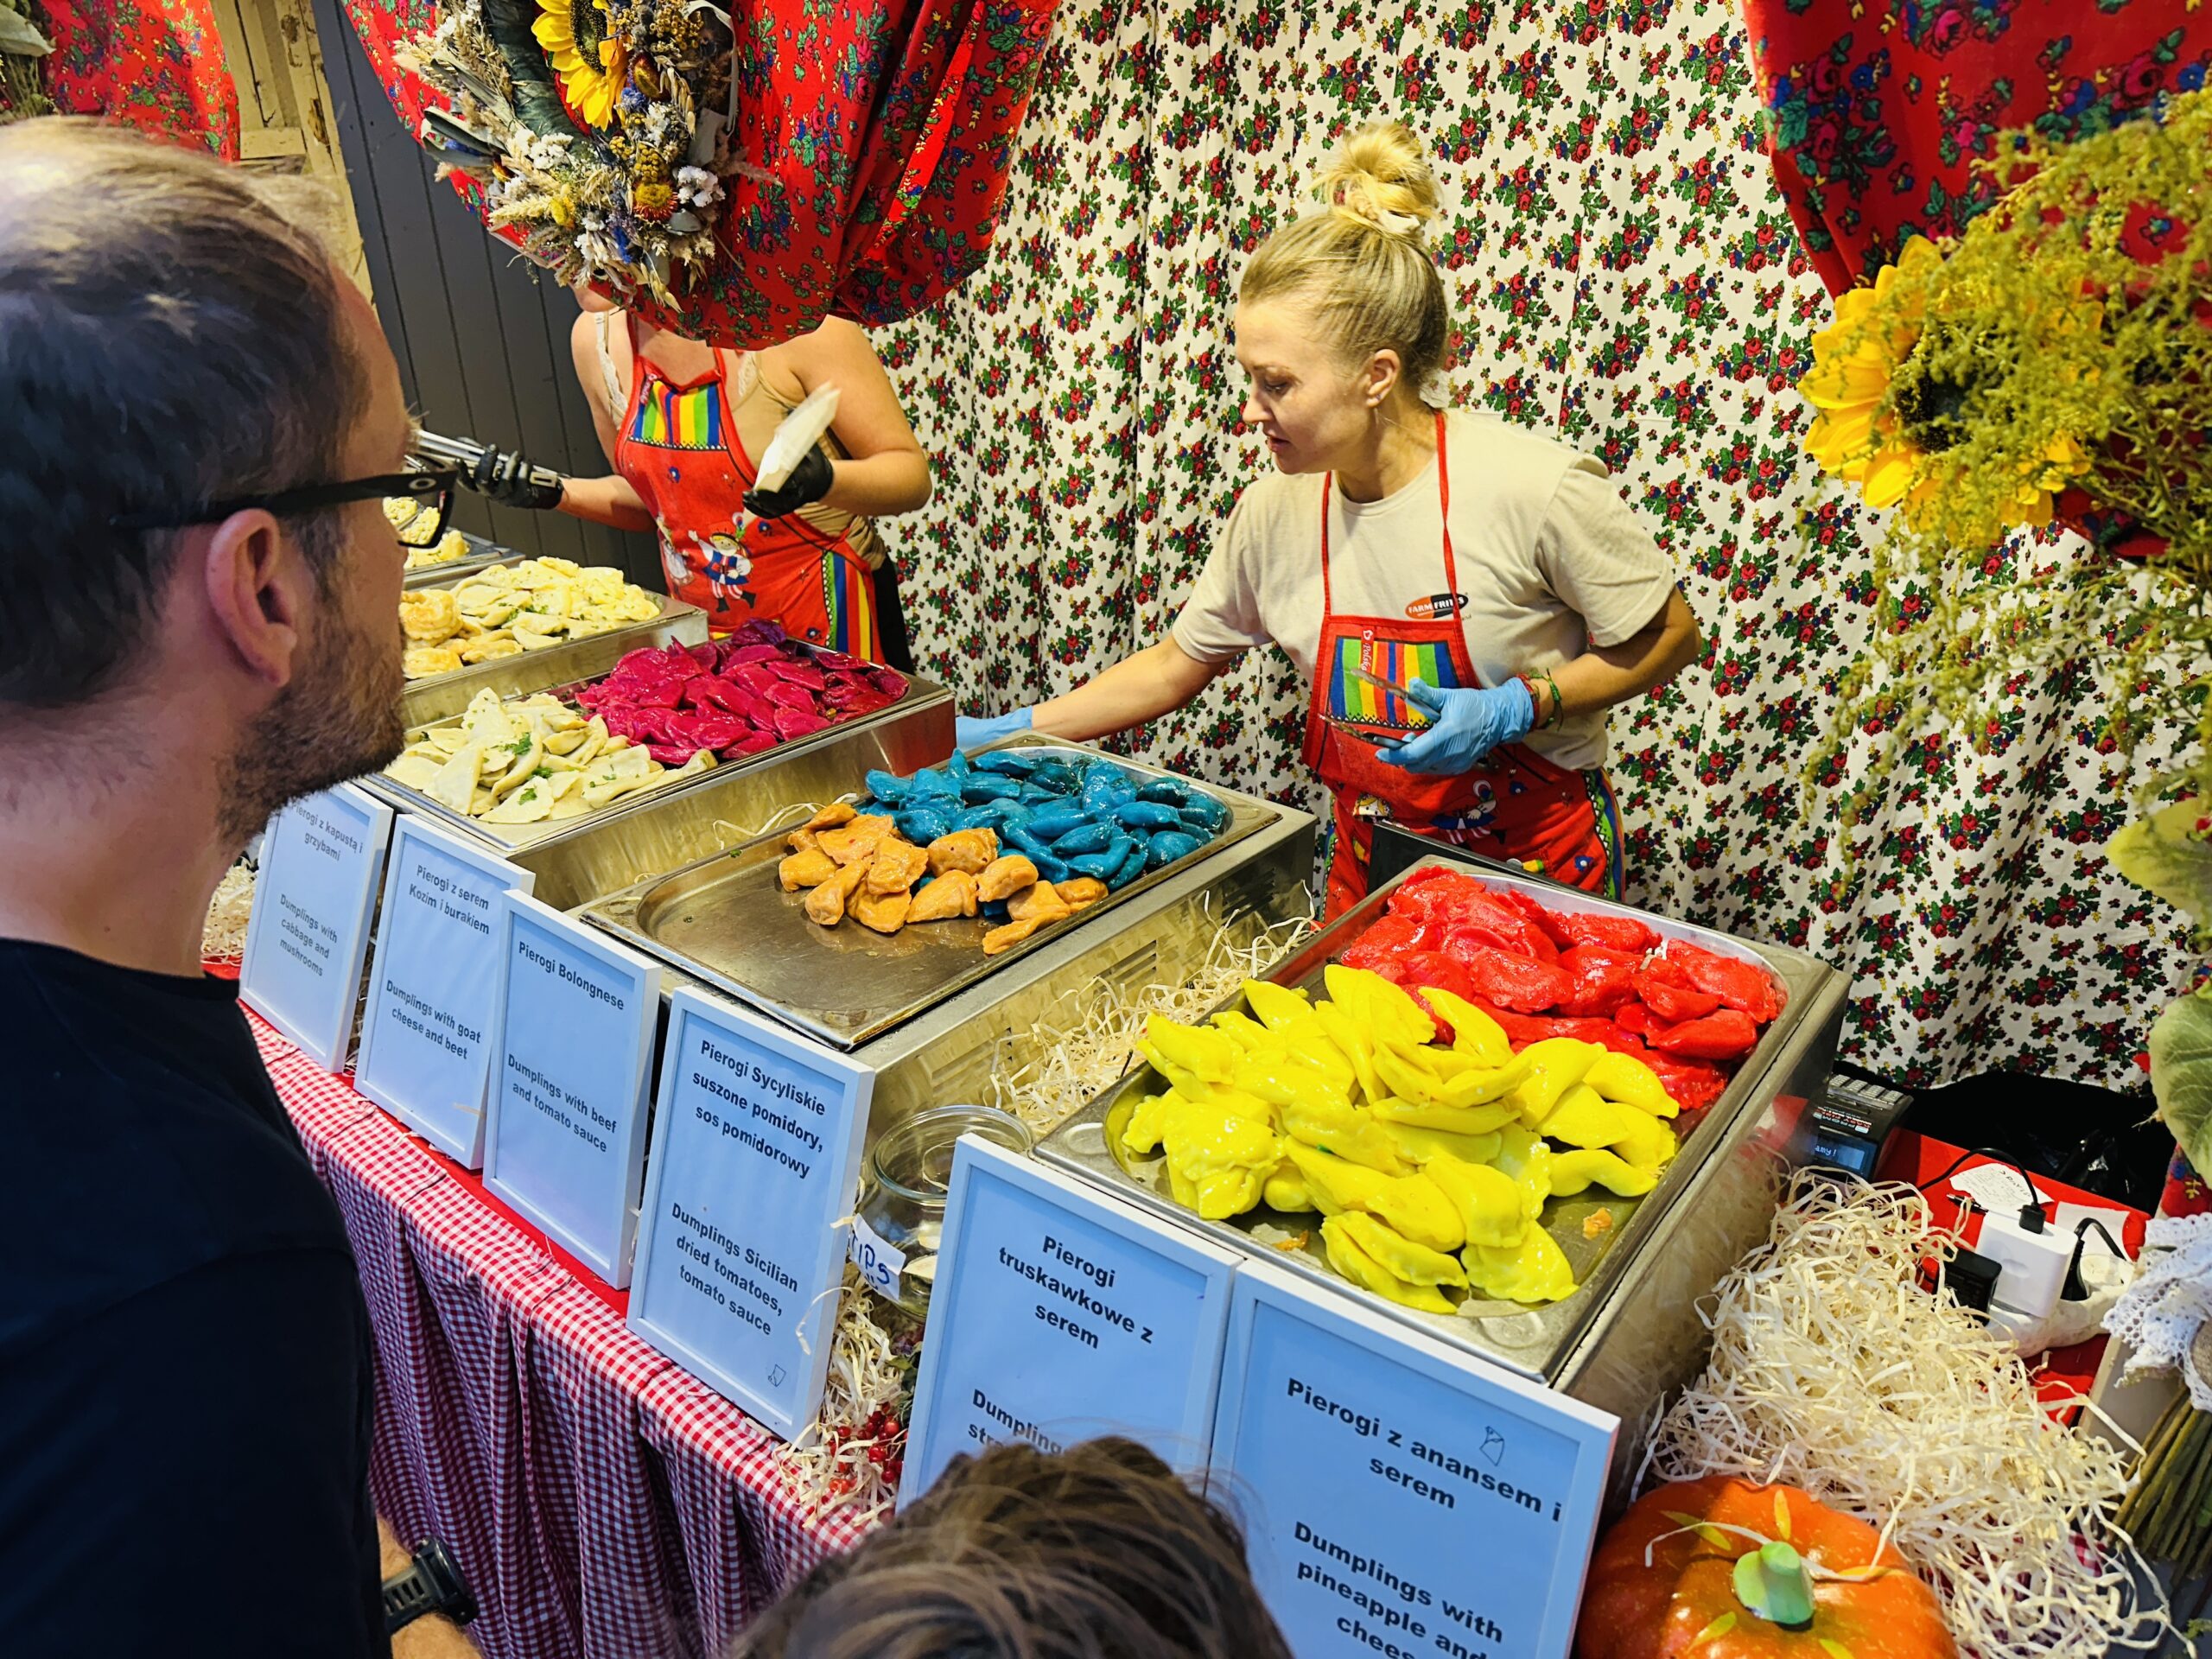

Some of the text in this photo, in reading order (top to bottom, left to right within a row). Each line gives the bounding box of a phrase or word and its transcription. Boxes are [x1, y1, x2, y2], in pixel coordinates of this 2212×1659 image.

[1408, 596, 1465, 613] FARM FRITS
[304, 832, 341, 861] grzybami
[319, 820, 324, 829] z
[325, 821, 358, 854] kapustą
[359, 842, 364, 854] i
[279, 893, 338, 944] Dumplings with
[409, 883, 490, 935] Kozim i burakiem
[416, 864, 489, 911] Pierogi z serem
[279, 938, 323, 976] mushrooms
[281, 918, 330, 959] cabbage and
[518, 941, 625, 1010] Pierogi Bolongnese
[385, 979, 481, 1044] Dumplings with goat
[391, 1007, 468, 1060] cheese and beet
[507, 1053, 617, 1134] Dumplings with beef
[701, 1039, 825, 1116] Pierogi Sycyliskie
[512, 1083, 607, 1154] and tomato sauce
[692, 1072, 823, 1154] suszone pomidory,
[696, 1106, 810, 1179] sos pomidorowy
[671, 1202, 798, 1293] Dumplings Sicilian
[677, 1236, 782, 1317] dried tomatoes,
[1042, 1235, 1116, 1288] Pierogi
[679, 1264, 772, 1336] tomato sauce
[998, 1246, 1154, 1345] truskawkowe z
[1034, 1304, 1099, 1350] serem
[972, 1389, 1065, 1455] Dumpling
[1287, 1377, 1562, 1522] Pierogi z anansem i
[1369, 1456, 1455, 1510] serem
[1294, 1521, 1503, 1643] Dumplings with
[1297, 1561, 1427, 1638] pineapple
